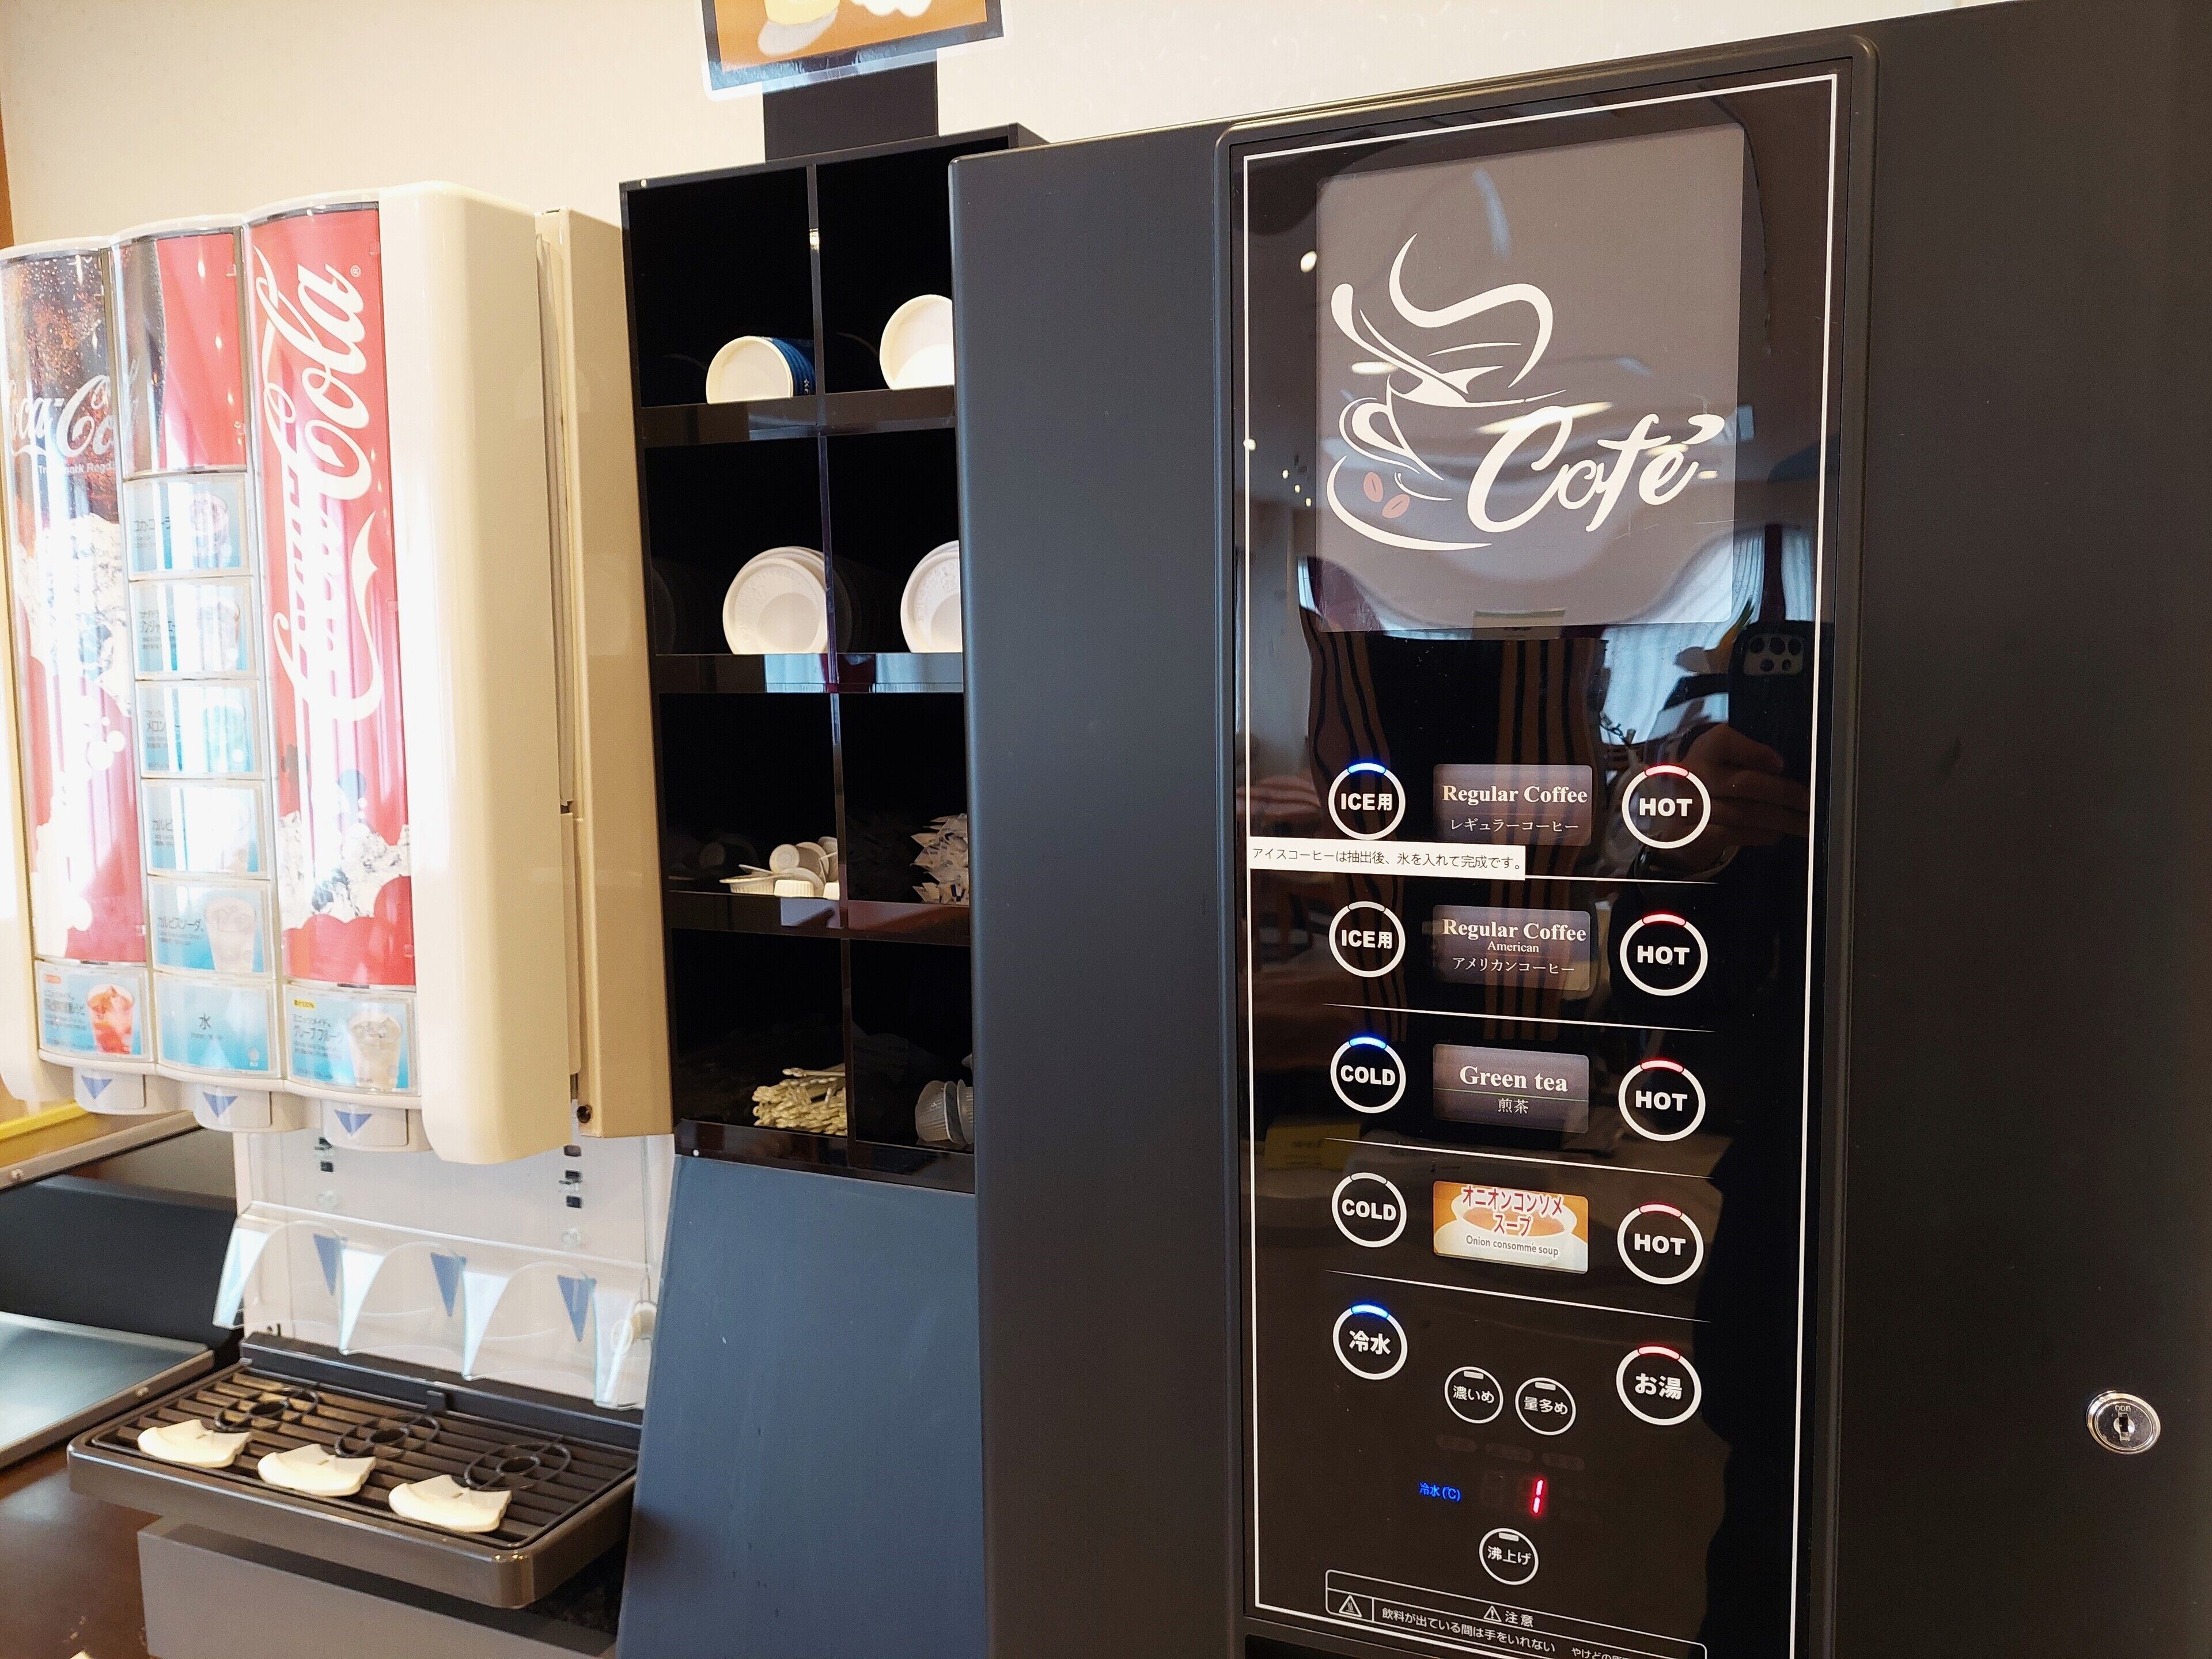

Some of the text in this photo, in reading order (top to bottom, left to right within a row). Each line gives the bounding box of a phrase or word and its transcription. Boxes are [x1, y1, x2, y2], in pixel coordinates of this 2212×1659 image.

[1467, 406, 1725, 532] Café
[1340, 793, 1393, 812] ICE用
[1442, 784, 1588, 806] Regular Coffee
[1639, 798, 1693, 817] HOT
[1450, 818, 1578, 833] レギュラーコーヒー
[1253, 847, 1521, 870] アイスコーヒーは抽出後、氷を入れて完成です。
[1341, 930, 1393, 950] ICE用
[1442, 918, 1586, 941] Regular Coffee
[1487, 940, 1540, 953] American
[1637, 945, 1690, 965] HOT
[1452, 956, 1575, 975] アメリカンコーヒー
[198, 1012, 212, 1030] 水
[1340, 1065, 1396, 1086] COLD
[1460, 1066, 1569, 1092] Green tea
[1497, 1097, 1529, 1115] 煎茶
[1635, 1090, 1688, 1111] HOT
[1341, 1200, 1397, 1221] COLD
[1462, 1185, 1562, 1216] オニオンコンソメ
[1494, 1214, 1532, 1237] スープ
[1466, 1235, 1559, 1258] Onion consommé soup
[1634, 1233, 1686, 1256] HOT
[1349, 1330, 1391, 1355] 冷水
[1452, 1385, 1495, 1405] 濃いめ
[1635, 1373, 1683, 1400] お湯
[1523, 1396, 1569, 1416] 量多め
[1532, 1479, 1544, 1514] 1
[1487, 1545, 1532, 1567] 沸上げ
[1382, 1607, 1555, 1653] 飲料が出ている間は手をいれない
[1504, 1611, 1535, 1628] 注意
